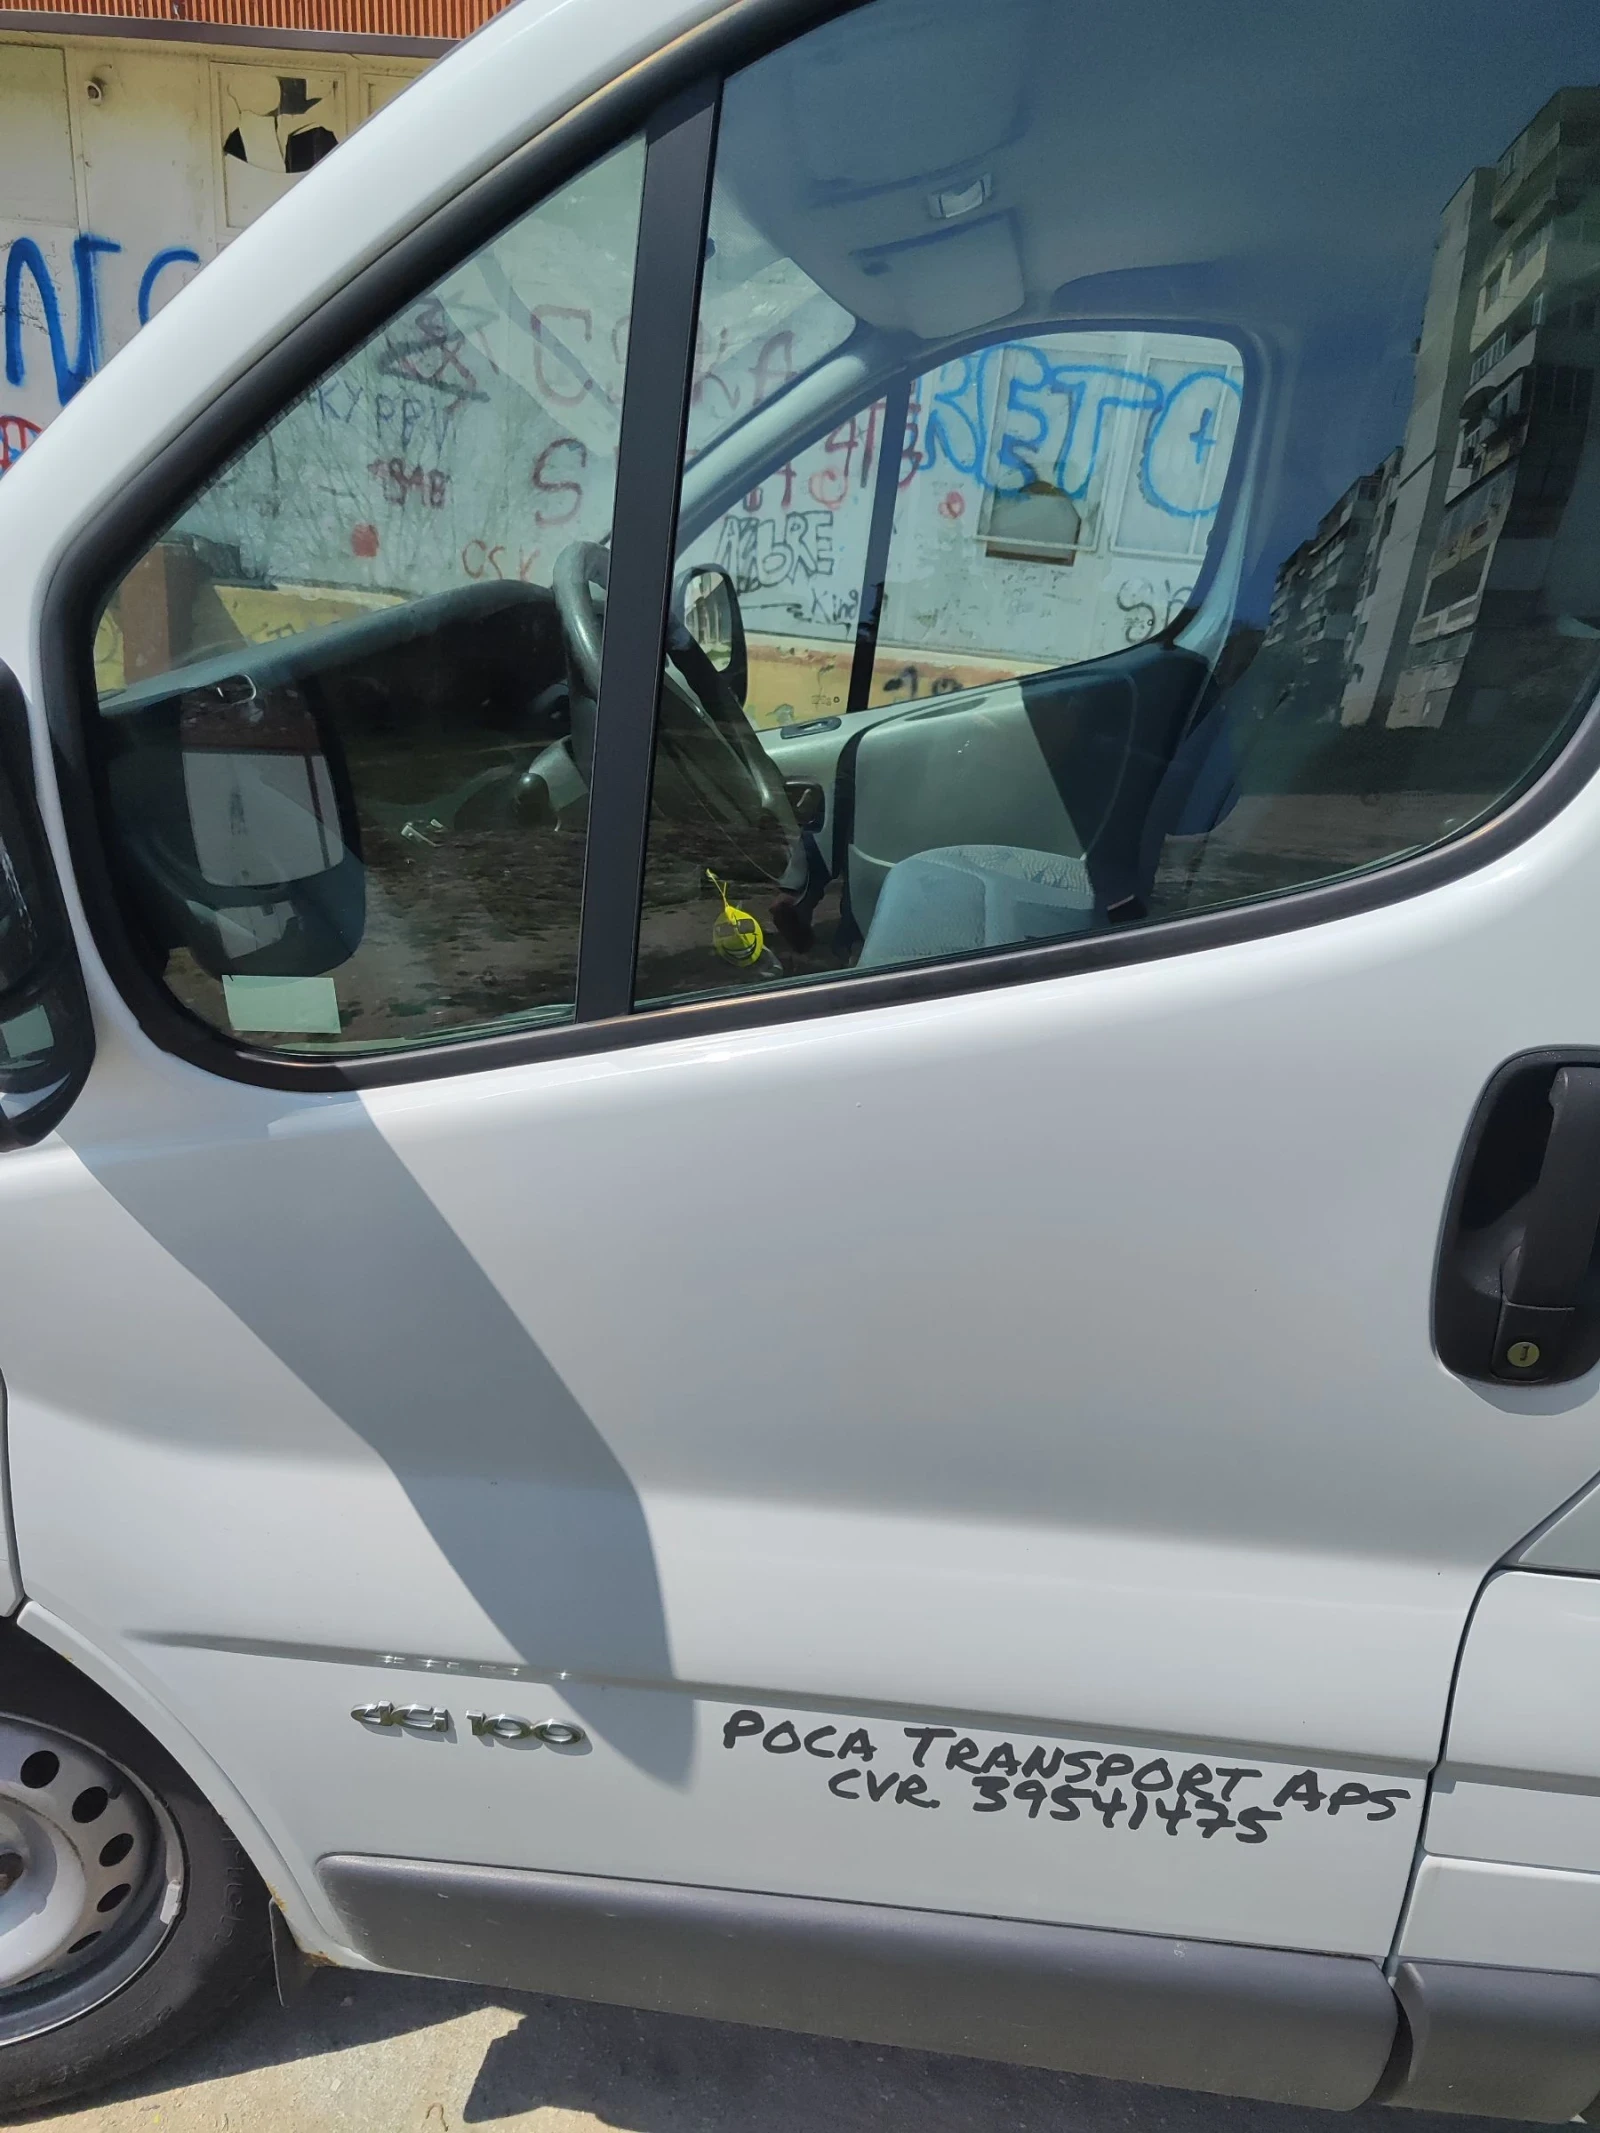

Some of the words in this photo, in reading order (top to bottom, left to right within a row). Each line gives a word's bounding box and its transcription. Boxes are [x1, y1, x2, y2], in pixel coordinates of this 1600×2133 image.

[466, 1709, 587, 1746] 100
[723, 1709, 877, 1762] POCA
[903, 1726, 1263, 1802] TRANSPORT
[1273, 1769, 1412, 1821] APS
[828, 1768, 941, 1809] CVR
[972, 1775, 1283, 1844] 39541475
